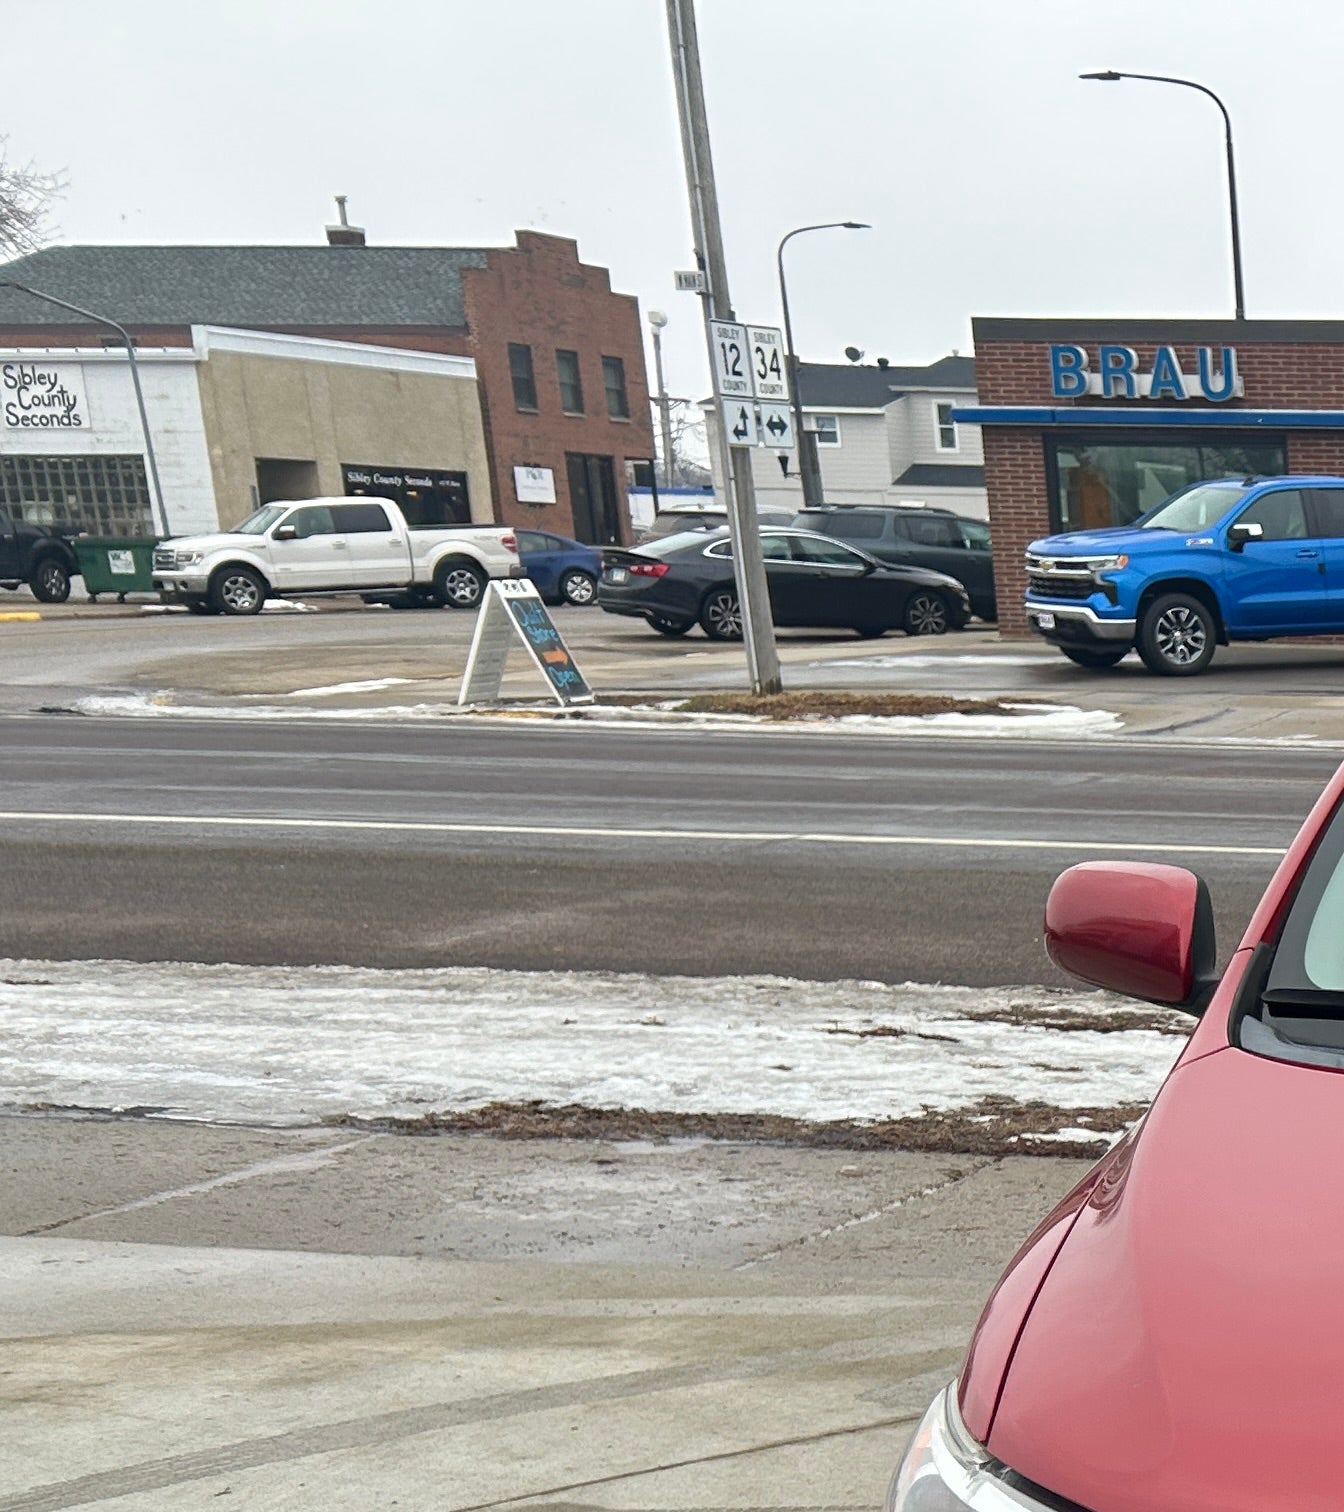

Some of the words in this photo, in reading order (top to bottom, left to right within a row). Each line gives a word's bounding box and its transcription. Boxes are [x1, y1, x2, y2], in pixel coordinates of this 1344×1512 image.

[717, 327, 740, 340] SIBLEY
[753, 332, 777, 343] SIBLEY
[721, 342, 743, 377] 12
[756, 346, 781, 381] 34
[1050, 344, 1236, 402] BRAU
[3, 364, 58, 393] Sibley
[723, 379, 747, 392] COUNTY
[759, 383, 784, 395] COUNTY
[17, 384, 77, 413] County
[6, 402, 82, 427] Seconds
